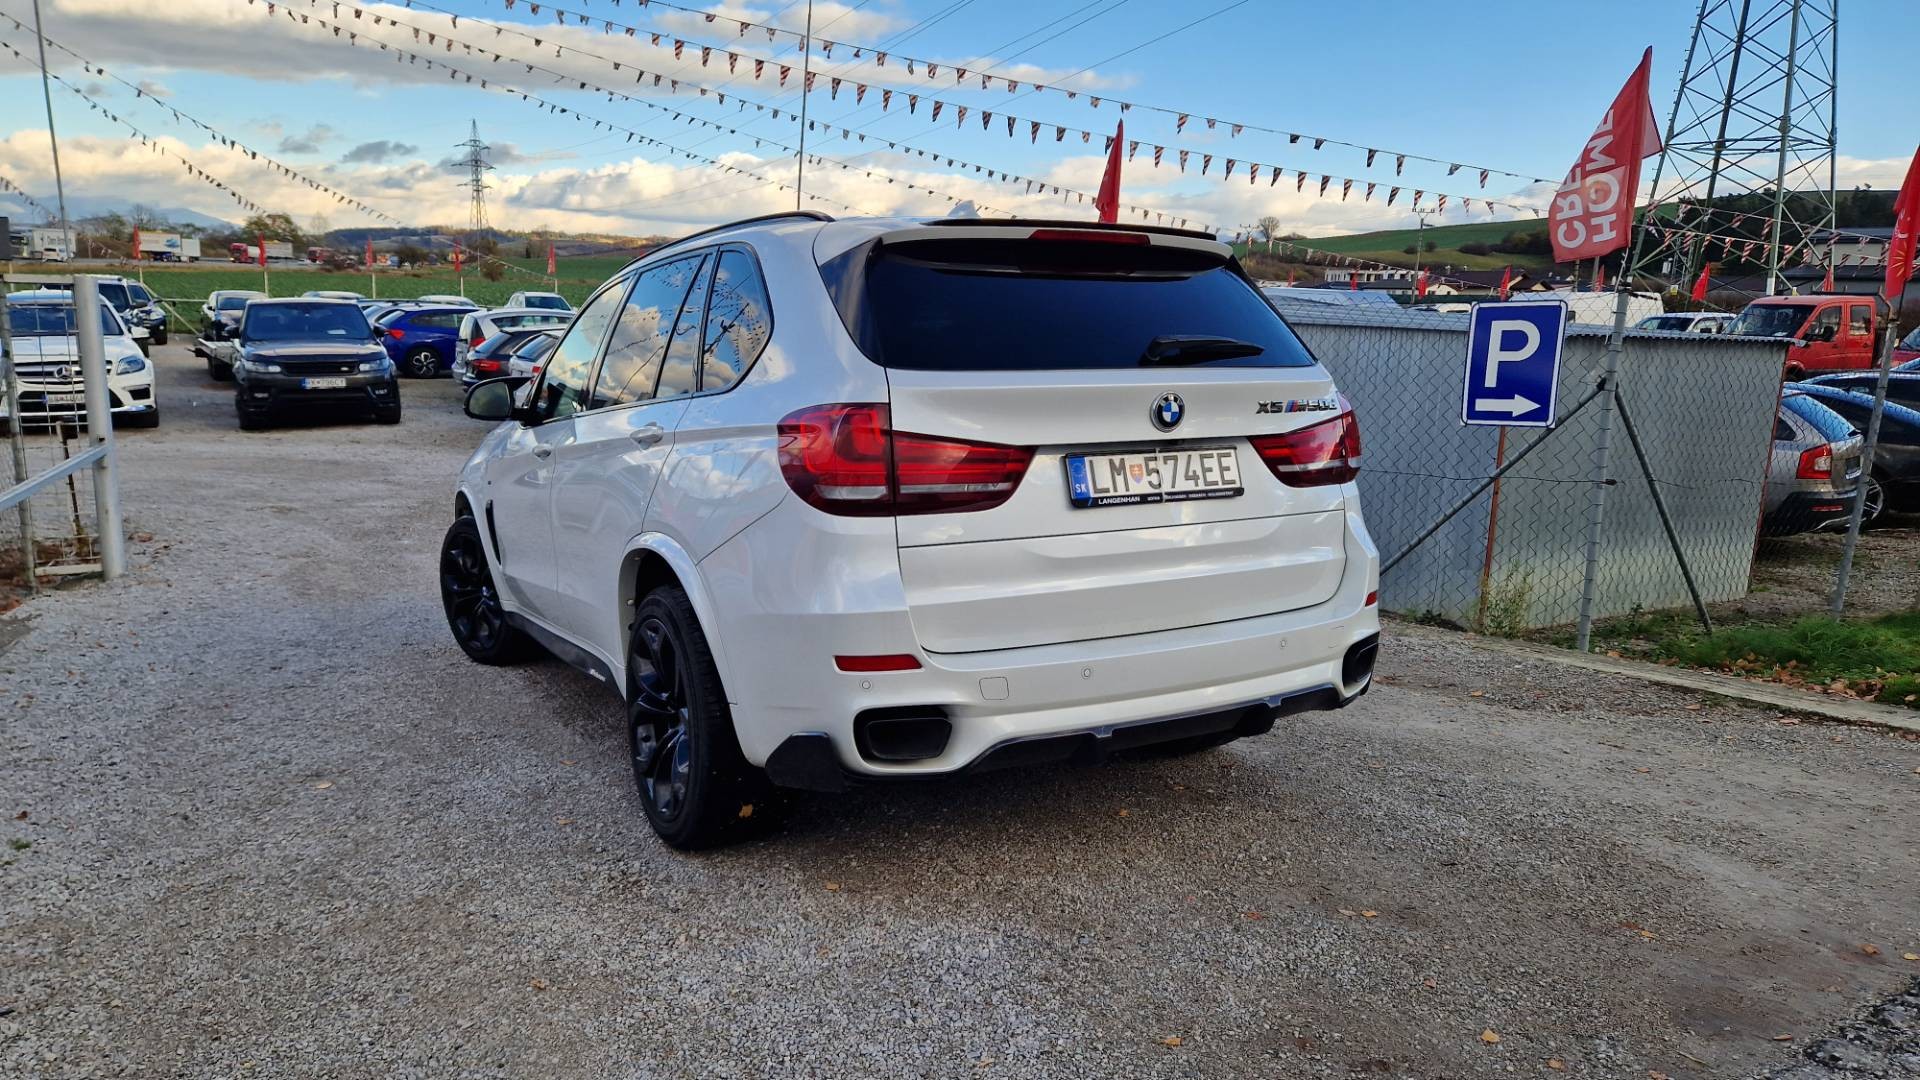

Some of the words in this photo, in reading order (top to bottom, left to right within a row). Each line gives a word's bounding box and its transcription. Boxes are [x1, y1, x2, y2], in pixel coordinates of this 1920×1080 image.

[1484, 319, 1541, 388] P
[1256, 401, 1283, 414] X5
[1089, 458, 1130, 494] LM
[1144, 452, 1236, 490] 574EE
[1075, 484, 1087, 493] SK
[1098, 496, 1141, 504] LANGENHAN
